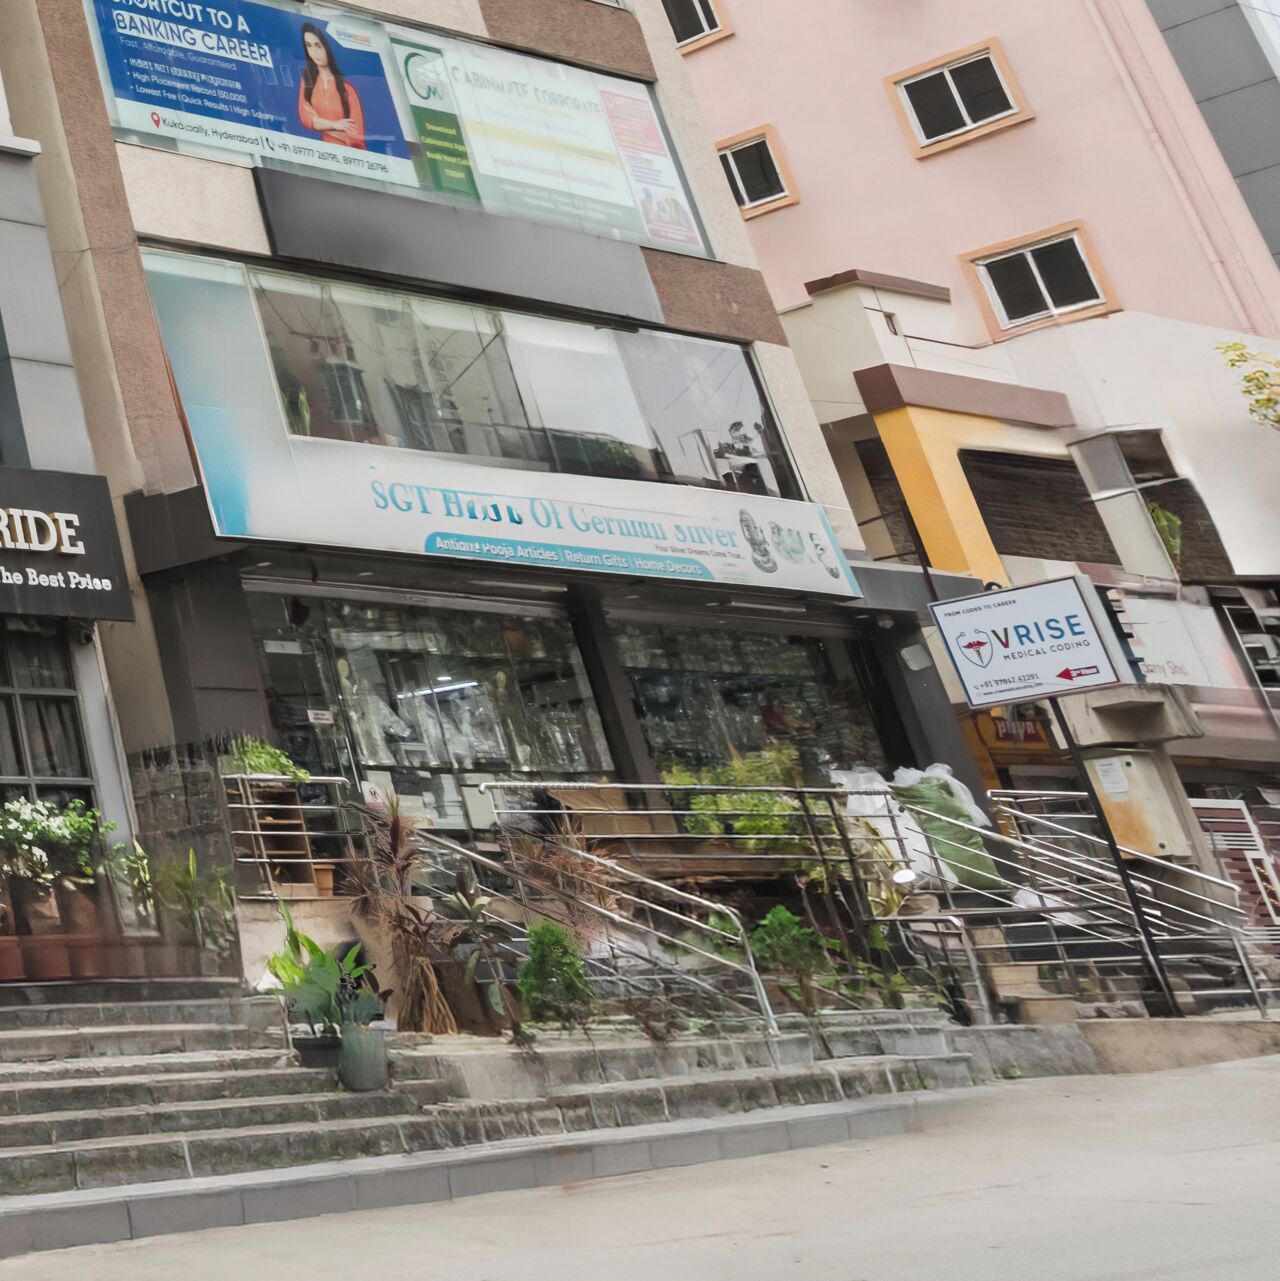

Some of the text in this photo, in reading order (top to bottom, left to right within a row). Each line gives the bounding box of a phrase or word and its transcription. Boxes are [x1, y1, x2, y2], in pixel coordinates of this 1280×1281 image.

[206, 7, 233, 29] TO
[237, 15, 251, 34] A
[114, 12, 271, 65] BANKING CAREER
[162, 117, 260, 147] Kukapally, Hyderabad
[369, 479, 434, 515] SGT
[517, 545, 559, 561] Articles
[604, 553, 629, 568] Gifts
[25, 568, 66, 589] Best
[962, 606, 983, 616] CODES
[991, 614, 1086, 650] VRISE
[1003, 639, 1091, 662] MEDICAL CODING
